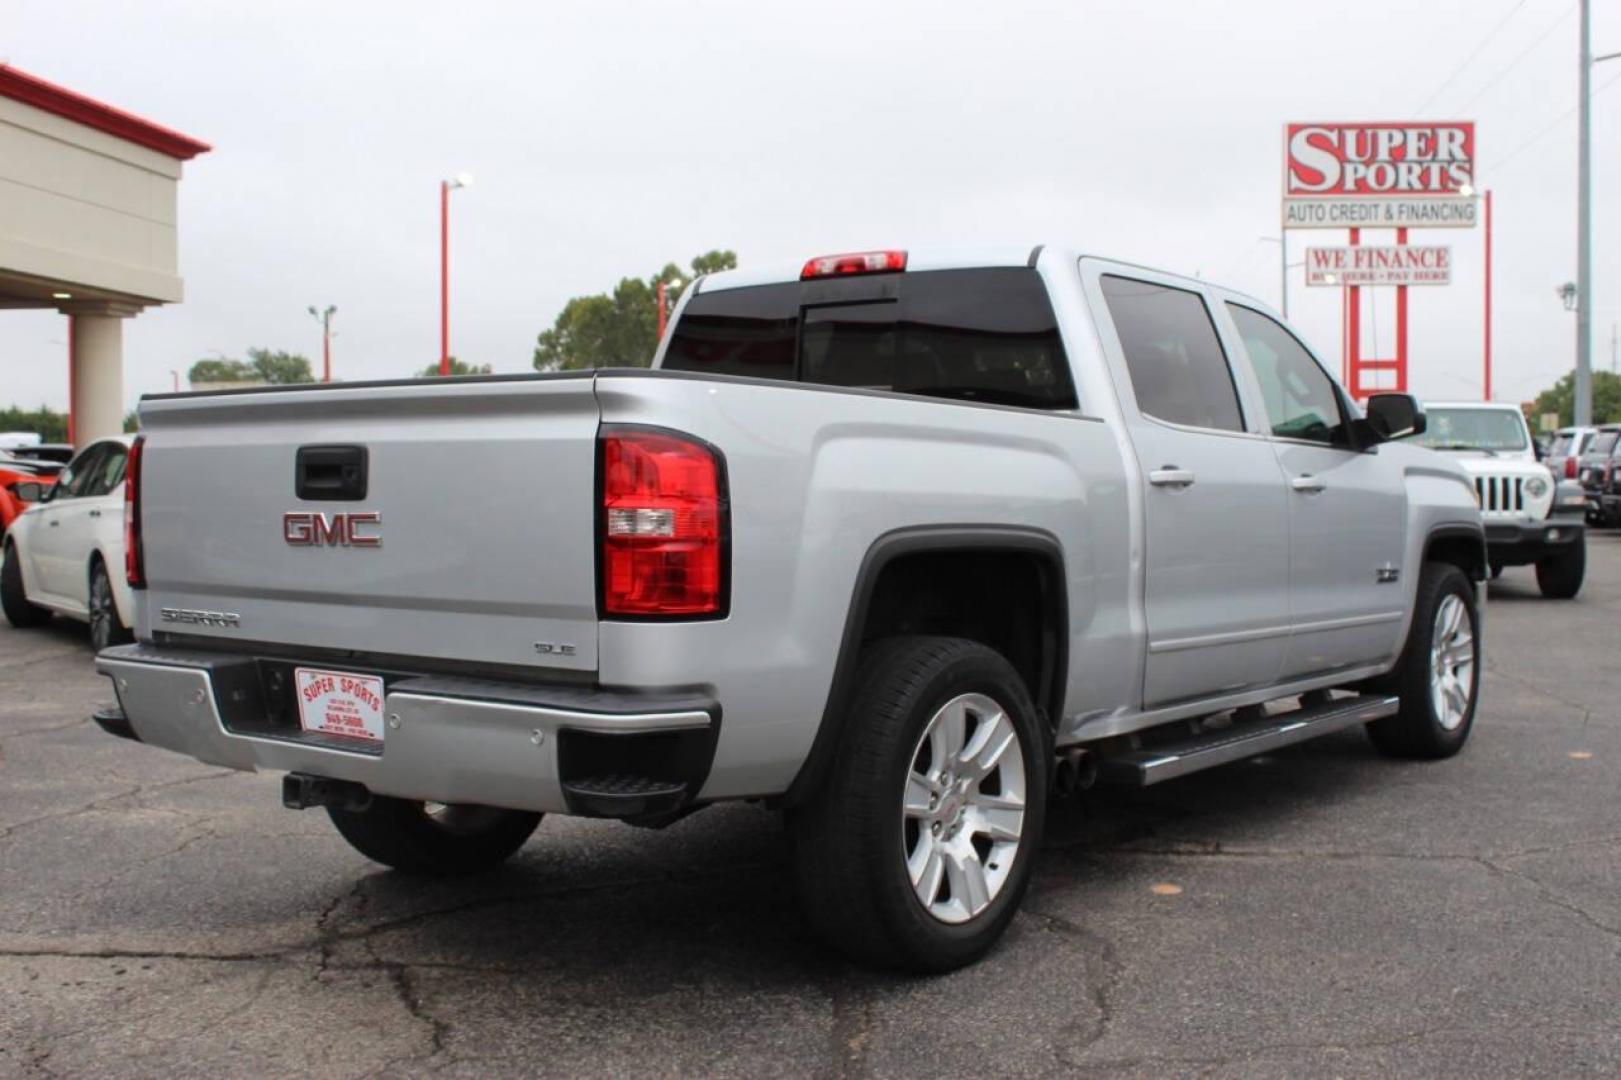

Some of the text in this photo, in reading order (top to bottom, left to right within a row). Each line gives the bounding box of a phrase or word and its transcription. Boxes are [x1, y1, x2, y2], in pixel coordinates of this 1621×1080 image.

[1290, 127, 1470, 191] SUPER
[1287, 203, 1475, 221] AUTO CREDIT & FINANCING
[1313, 248, 1449, 268] WE FINANCE
[283, 511, 382, 547] GMC
[160, 607, 240, 628] SIERRA
[534, 642, 576, 657] SLE
[303, 676, 380, 712] SUPER SPORTS
